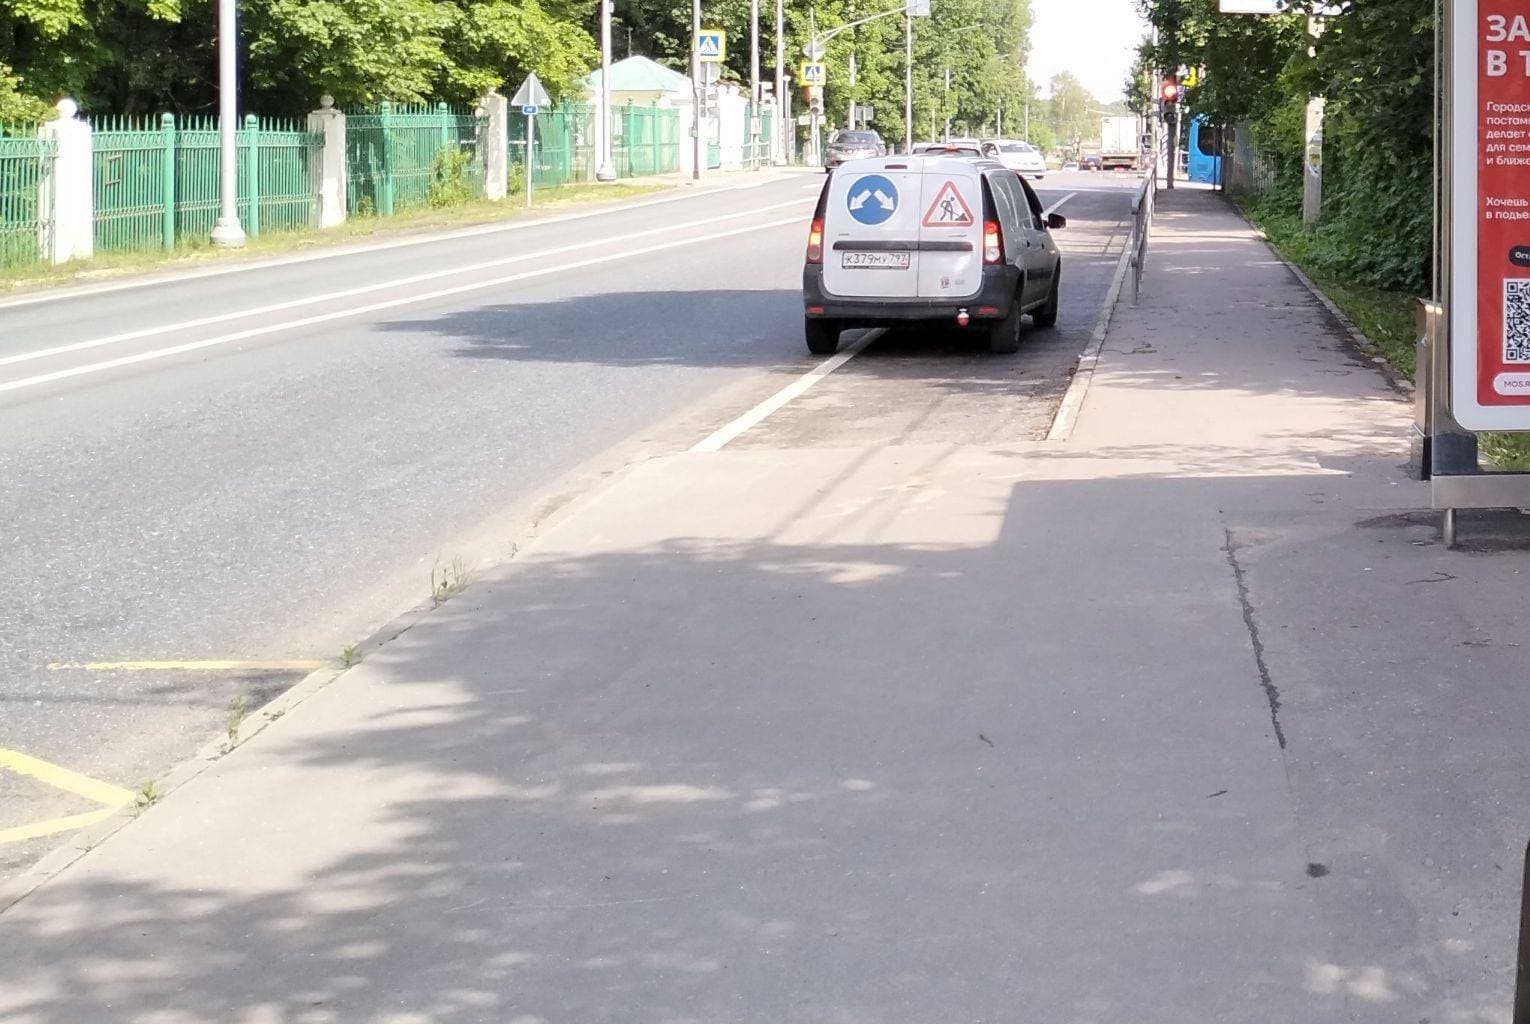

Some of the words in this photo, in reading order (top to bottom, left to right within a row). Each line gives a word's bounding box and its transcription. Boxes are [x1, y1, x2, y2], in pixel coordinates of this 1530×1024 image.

[1487, 50, 1507, 77] В
[1486, 130, 1526, 140] делает
[1486, 144, 1506, 153] для
[1486, 157, 1494, 165] и
[1486, 196, 1529, 207] Хочешь
[1486, 211, 1493, 219] в
